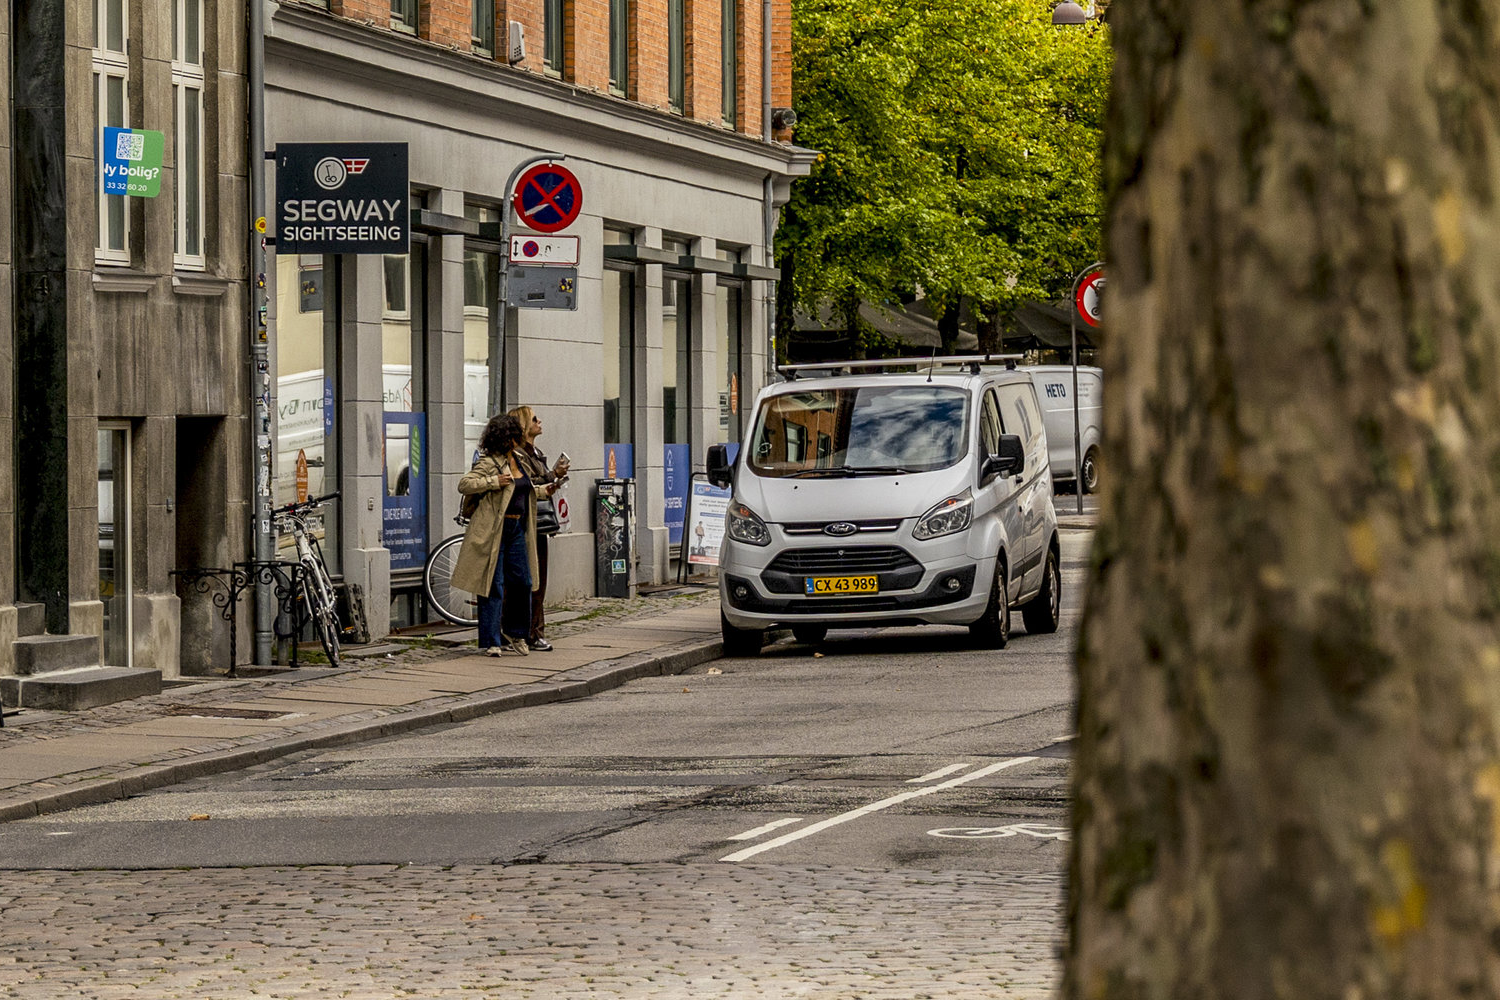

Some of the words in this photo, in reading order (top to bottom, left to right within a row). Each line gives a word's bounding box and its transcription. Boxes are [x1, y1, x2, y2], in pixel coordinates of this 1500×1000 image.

[119, 165, 159, 180] bolig?
[283, 199, 401, 221] SEGWAY
[283, 226, 401, 241] SIGHTSEEING
[1045, 383, 1066, 398] HETO
[831, 524, 849, 533] Ford
[815, 580, 831, 591] CX
[835, 579, 850, 590] 43
[853, 578, 876, 590] 989
